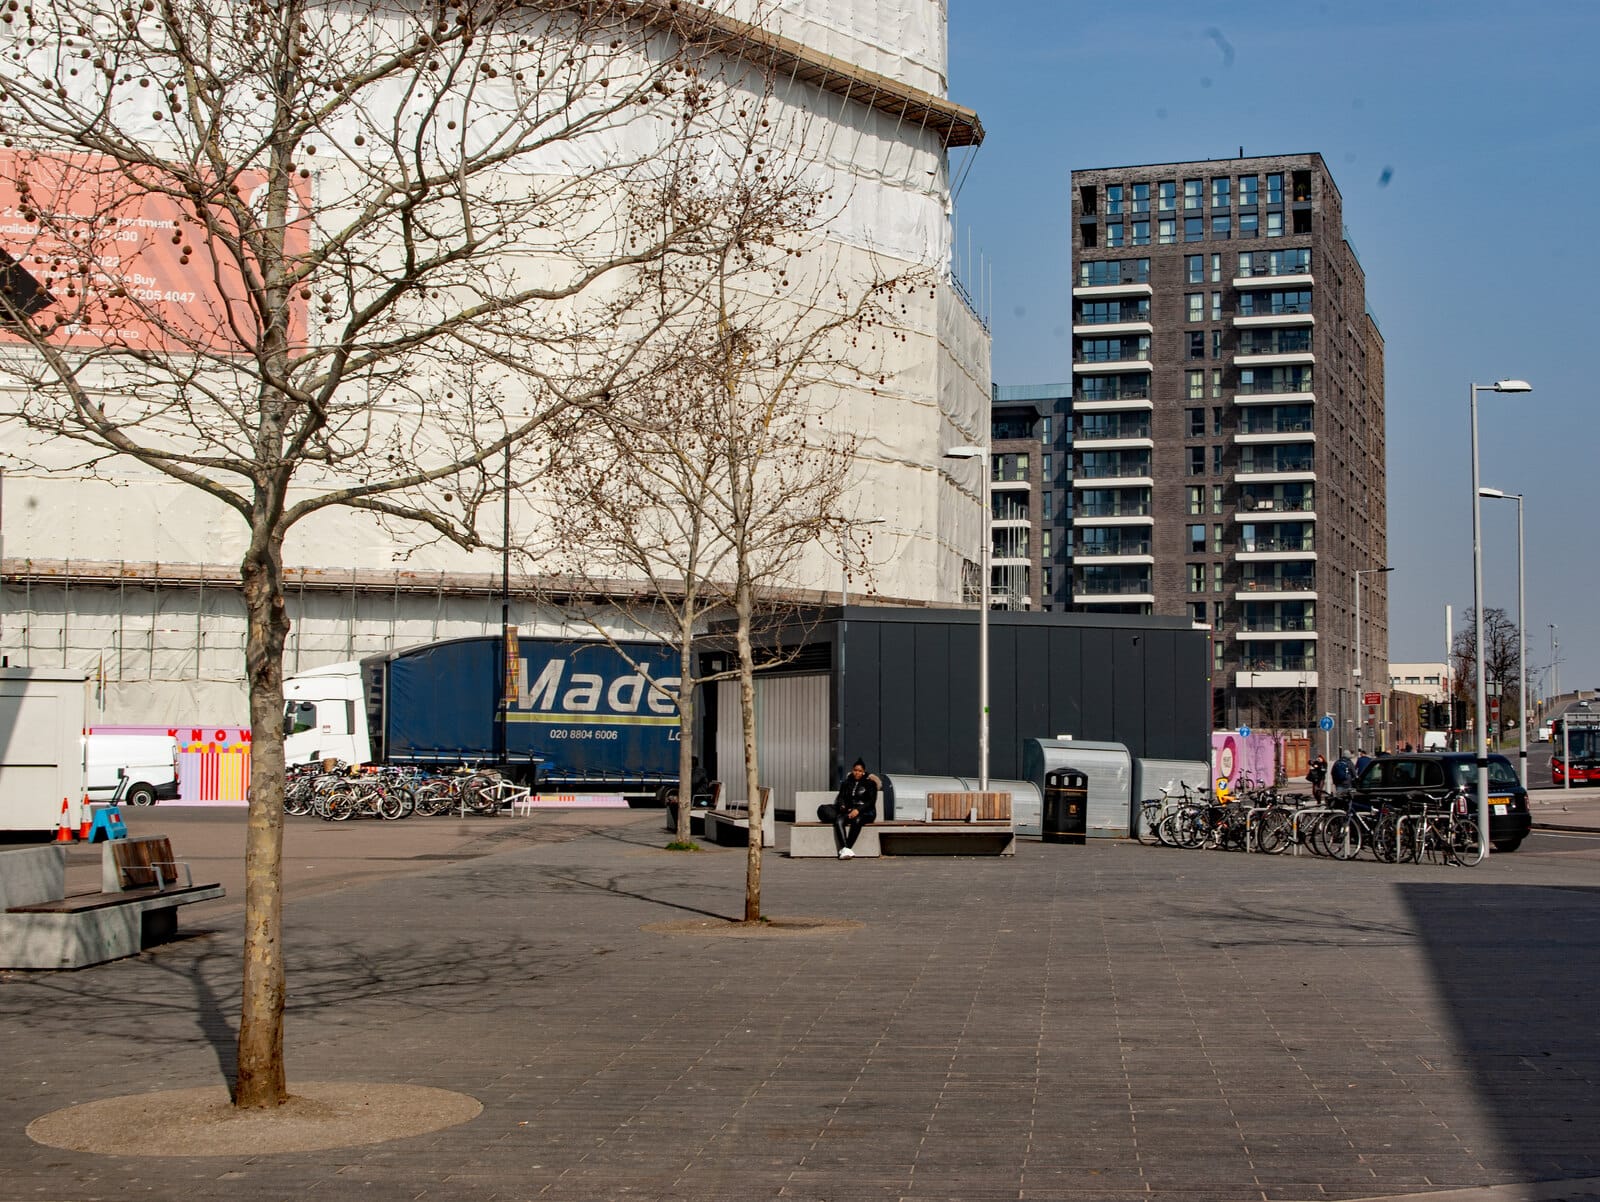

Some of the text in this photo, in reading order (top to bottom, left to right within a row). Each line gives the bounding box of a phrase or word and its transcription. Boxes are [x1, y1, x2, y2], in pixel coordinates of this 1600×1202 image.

[108, 217, 180, 229] partment
[133, 274, 156, 287] Buy
[164, 291, 196, 303] 4047
[550, 729, 618, 740] 020 8804 6006
